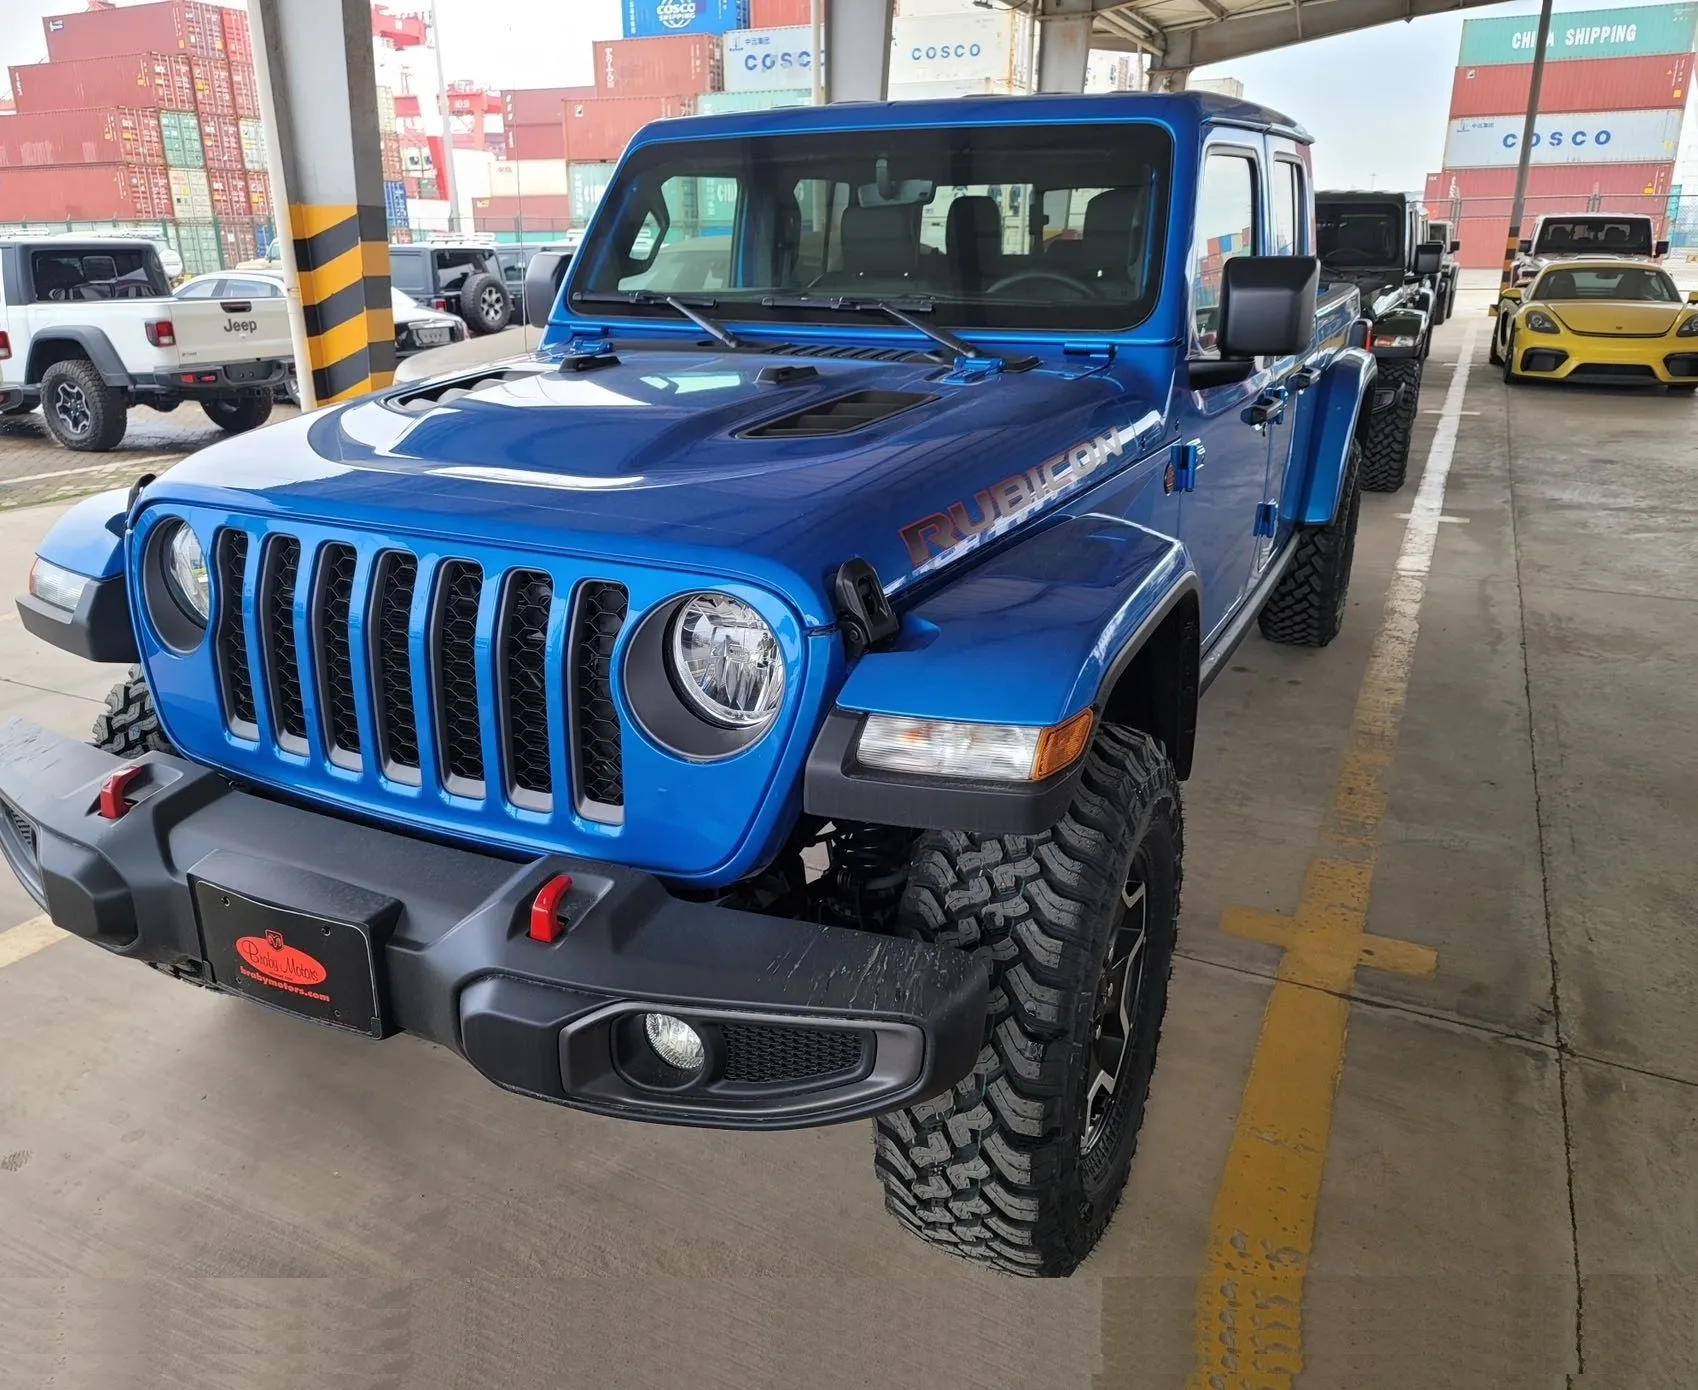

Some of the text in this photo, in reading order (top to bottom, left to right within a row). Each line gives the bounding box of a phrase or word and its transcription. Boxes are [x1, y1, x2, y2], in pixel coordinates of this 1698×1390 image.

[656, 3, 696, 15] COSCO
[658, 12, 696, 22] SHIPPING
[1512, 24, 1637, 49] CHIA SHIPPING
[911, 43, 981, 61] COSCO
[224, 318, 257, 334] Jeep
[899, 425, 1125, 567] RUBICON
[241, 940, 318, 981] Braby Motors
[239, 966, 330, 1002] brabymotors.com
